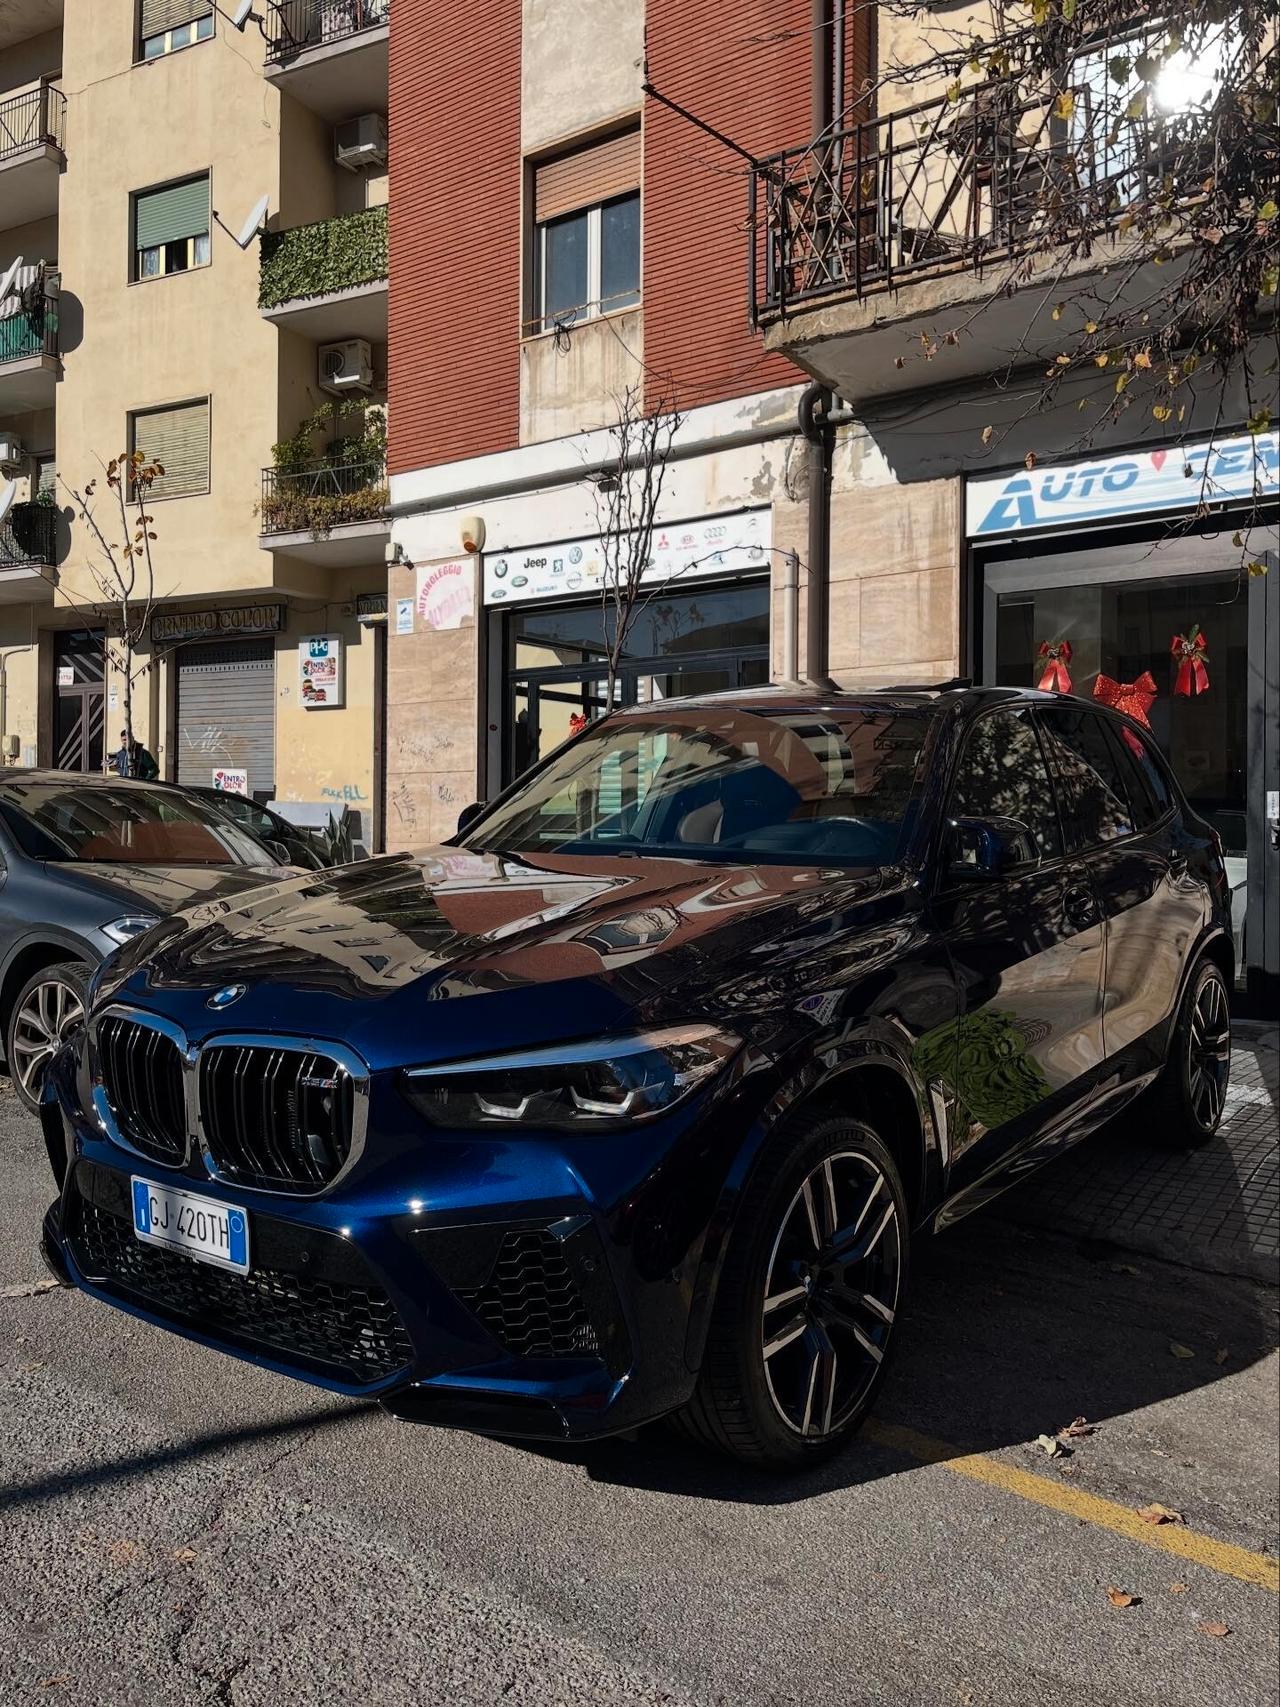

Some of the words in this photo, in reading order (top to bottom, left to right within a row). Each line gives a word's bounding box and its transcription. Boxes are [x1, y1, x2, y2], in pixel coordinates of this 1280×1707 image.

[976, 462, 1139, 532] AUTO
[524, 558, 547, 569] Jeep
[418, 564, 462, 616] AUTONOLEGGIO
[310, 640, 328, 654] PPG
[150, 1197, 168, 1229] GJ
[177, 1206, 229, 1249] 420TH
